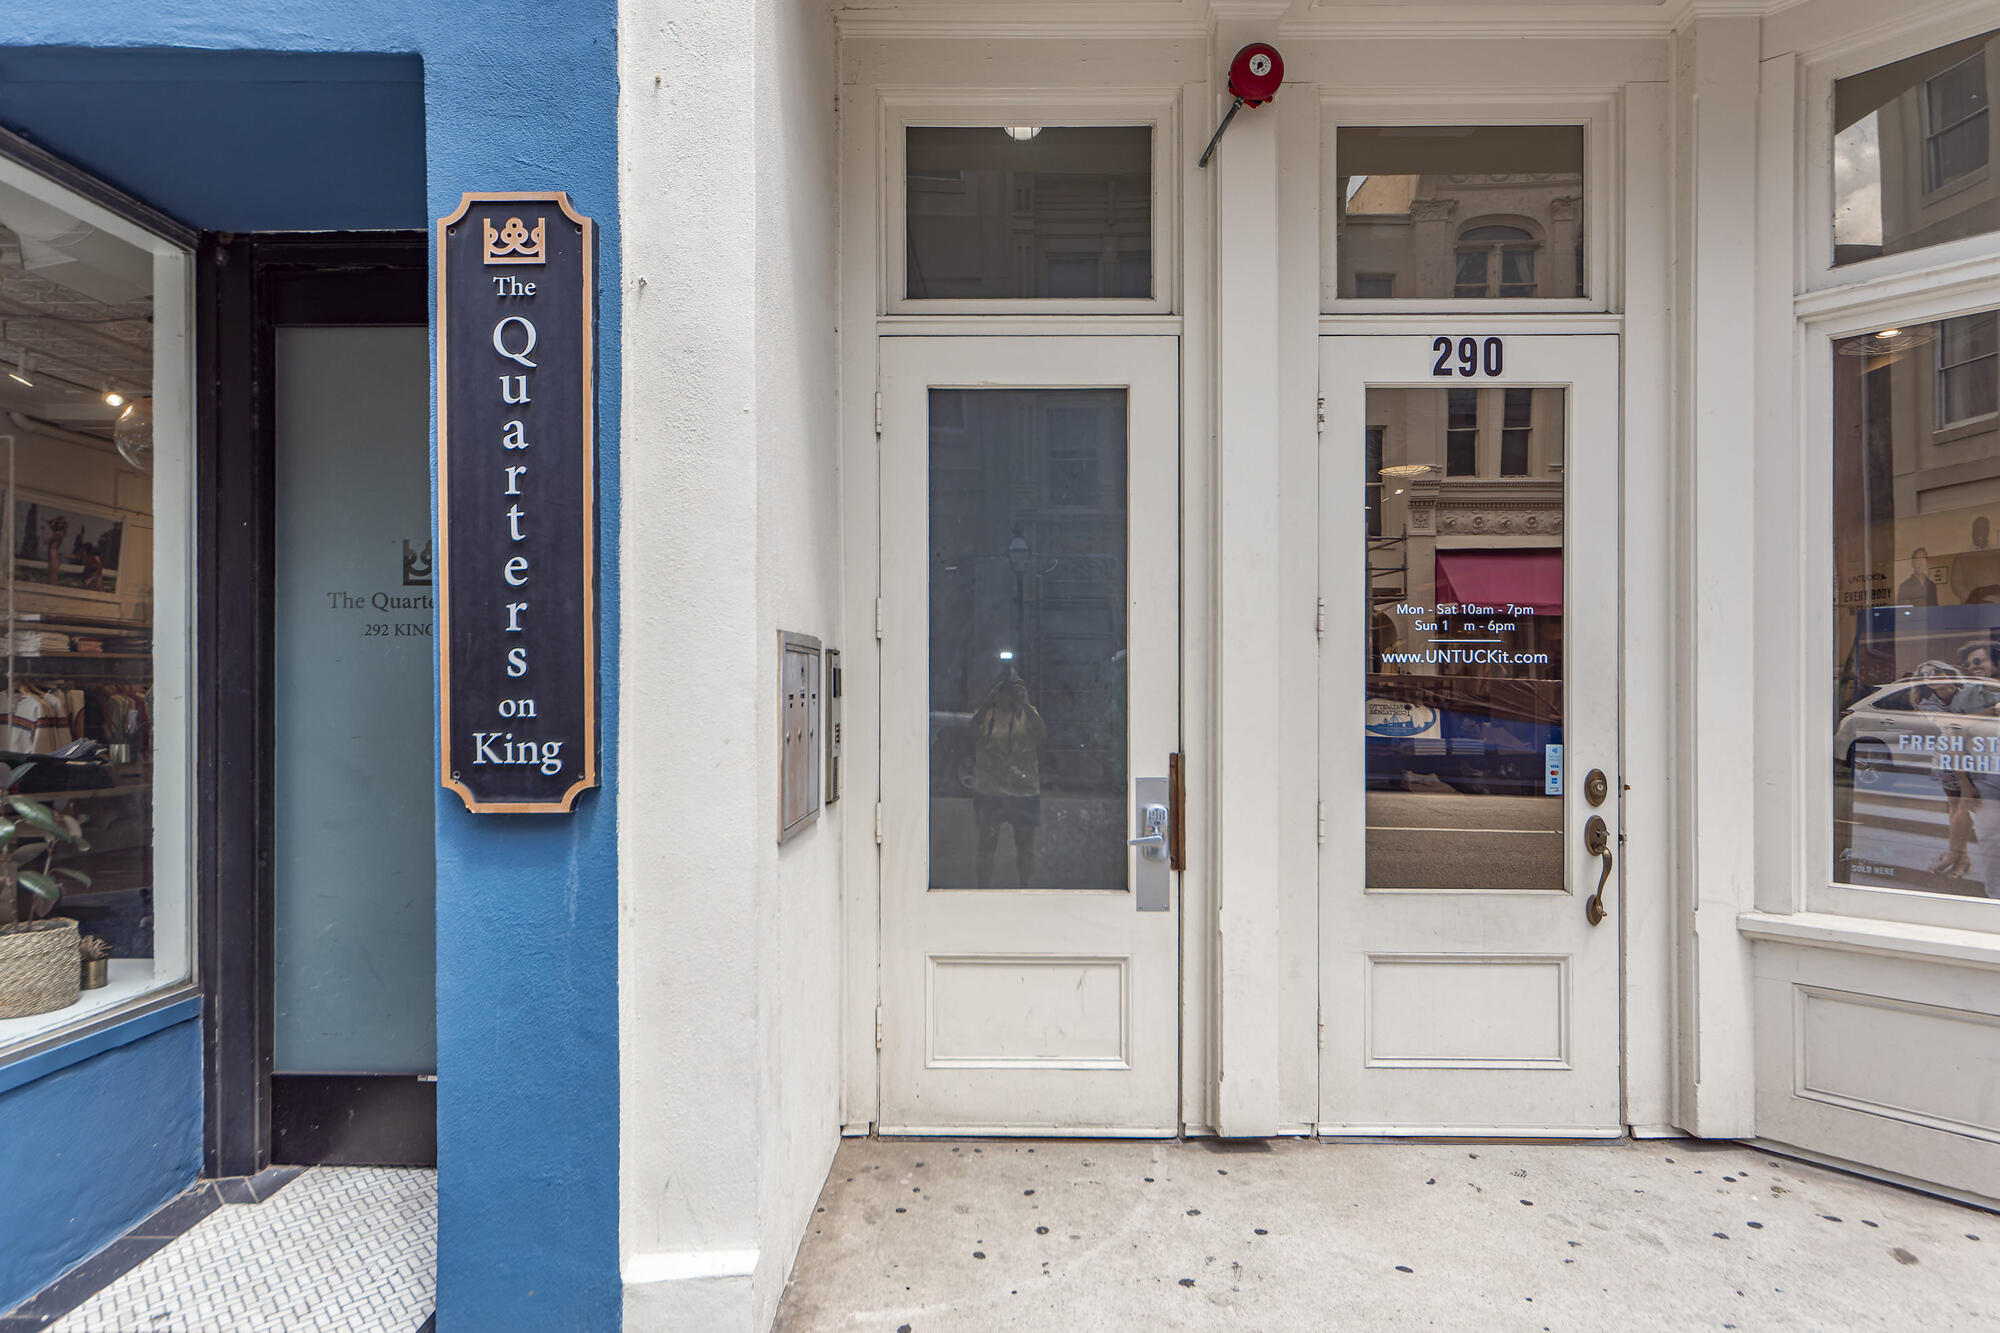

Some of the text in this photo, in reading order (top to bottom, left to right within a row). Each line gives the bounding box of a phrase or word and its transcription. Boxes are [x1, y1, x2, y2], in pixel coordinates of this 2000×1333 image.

[493, 275, 537, 297] The
[1433, 336, 1503, 377] 290
[492, 316, 538, 678] Quarters
[327, 591, 366, 609] The
[1396, 604, 1424, 615] Mon
[1436, 604, 1458, 615] Sat
[1460, 604, 1494, 615] 10am
[1506, 604, 1534, 617] 7pm
[364, 624, 389, 636] 292
[1415, 620, 1438, 631] Sun
[1487, 620, 1516, 634] 6pm
[1381, 649, 1548, 664] www.UNTUCKit.com
[498, 697, 537, 718] on
[1899, 734, 1966, 752] FRESH
[472, 732, 563, 776] King
